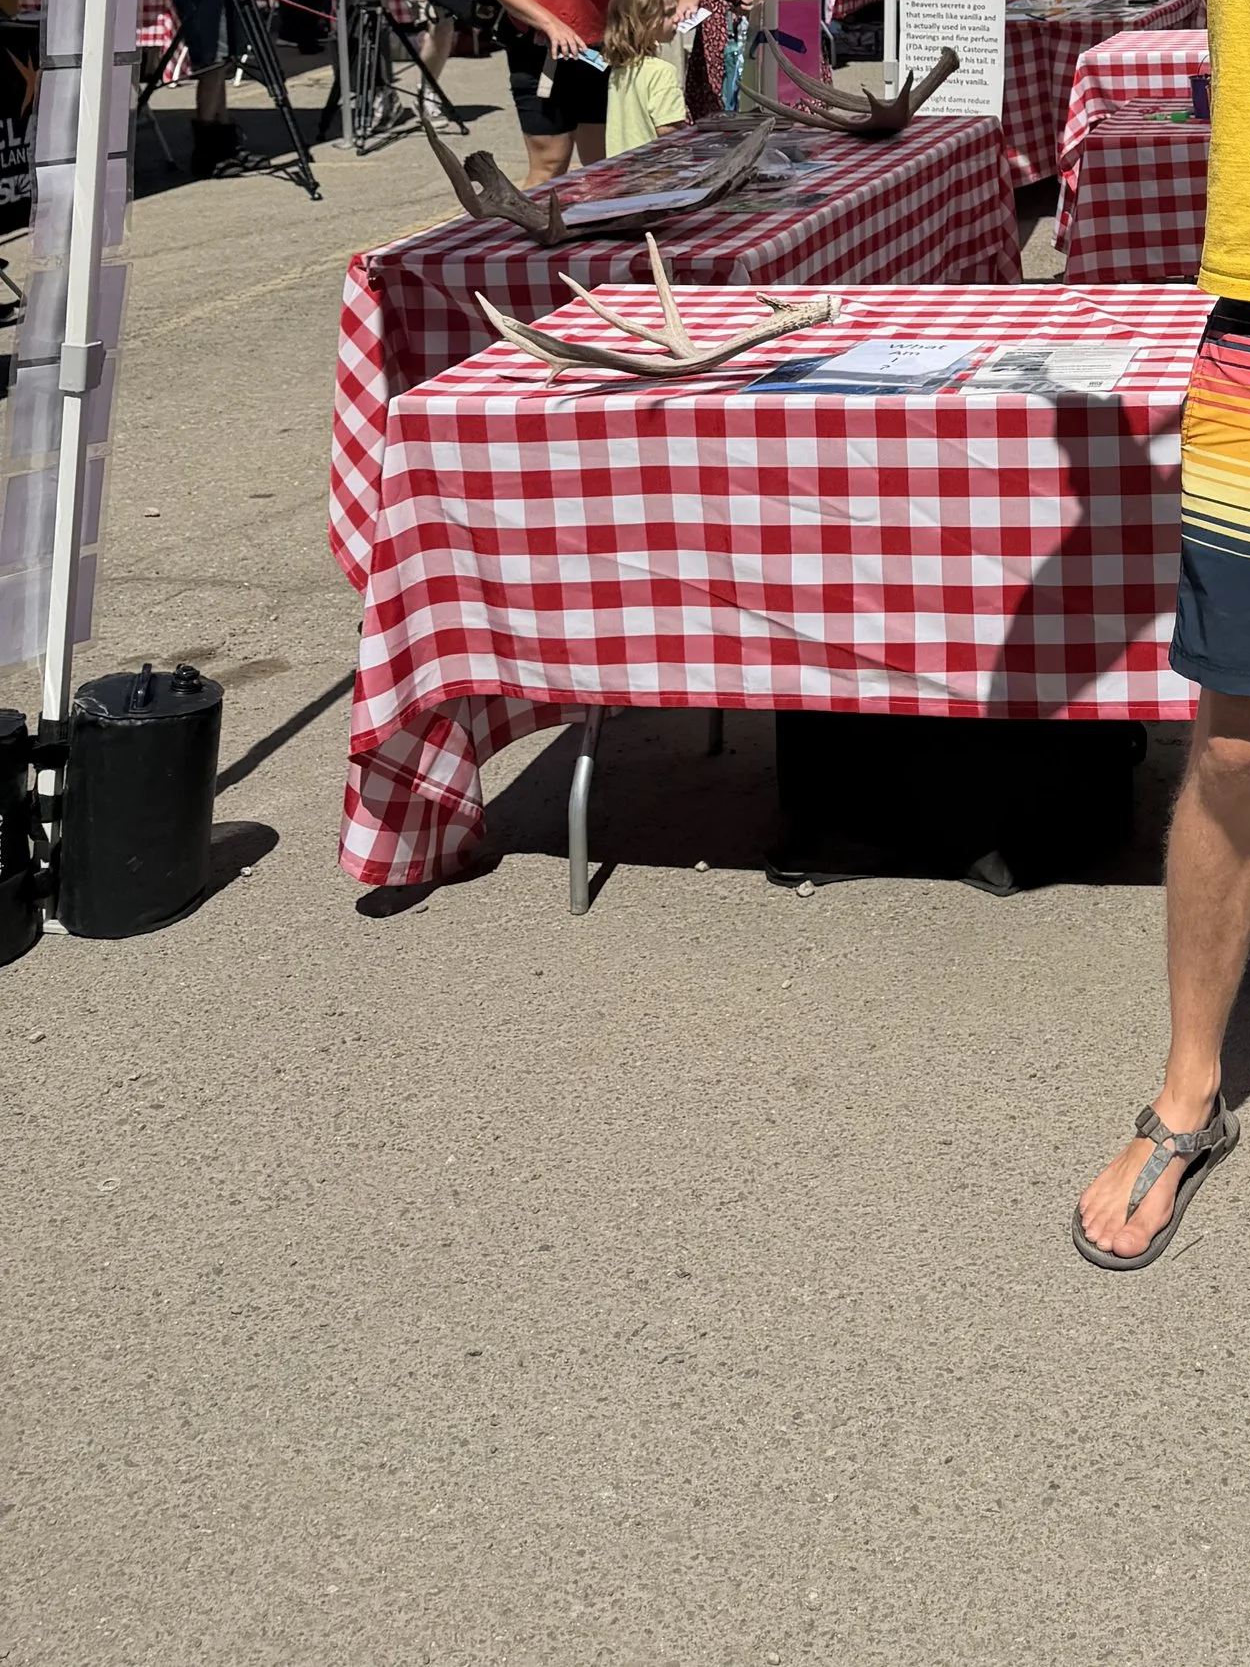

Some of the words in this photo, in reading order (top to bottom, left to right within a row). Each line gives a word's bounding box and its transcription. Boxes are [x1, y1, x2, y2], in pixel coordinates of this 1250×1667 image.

[911, 0, 939, 8] Beavers
[945, 12, 958, 20] like
[984, 14, 996, 22] and
